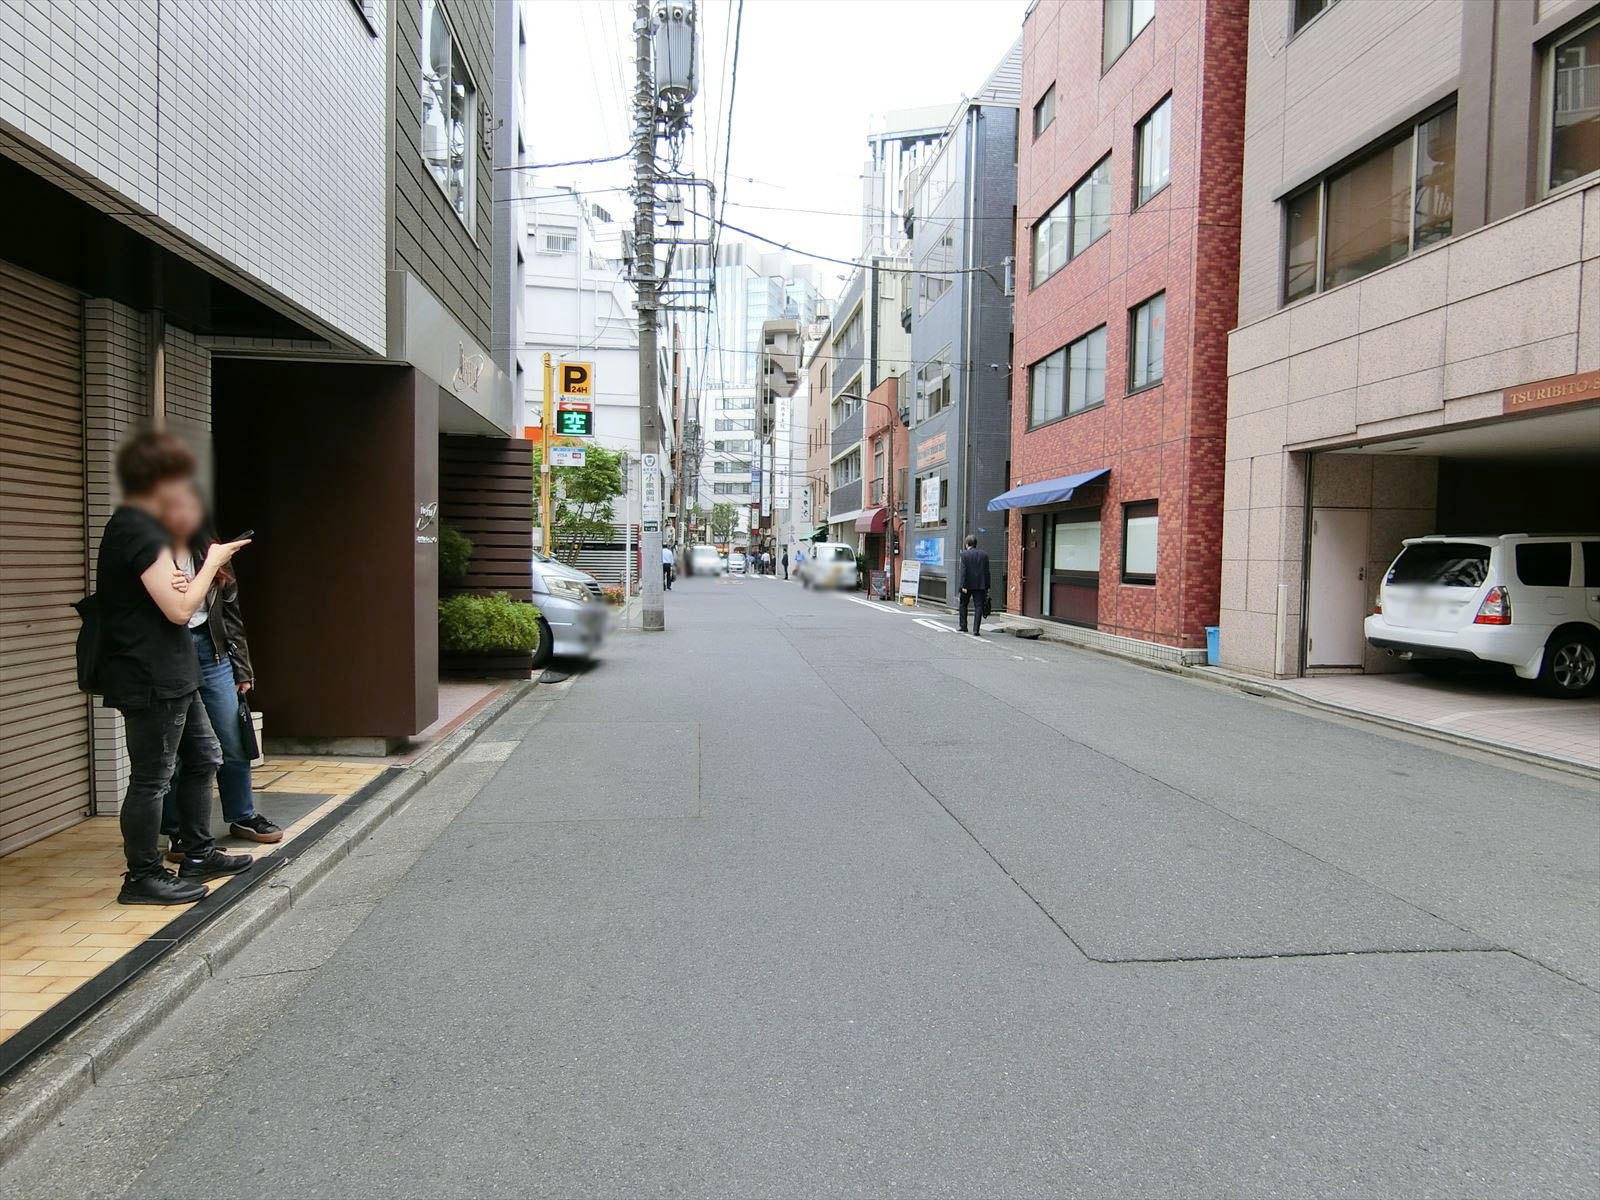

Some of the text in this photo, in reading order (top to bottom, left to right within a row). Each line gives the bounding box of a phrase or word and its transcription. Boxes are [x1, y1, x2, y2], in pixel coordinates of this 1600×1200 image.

[564, 365, 587, 393] P
[571, 386, 588, 394] 24H
[563, 412, 587, 434] 空
